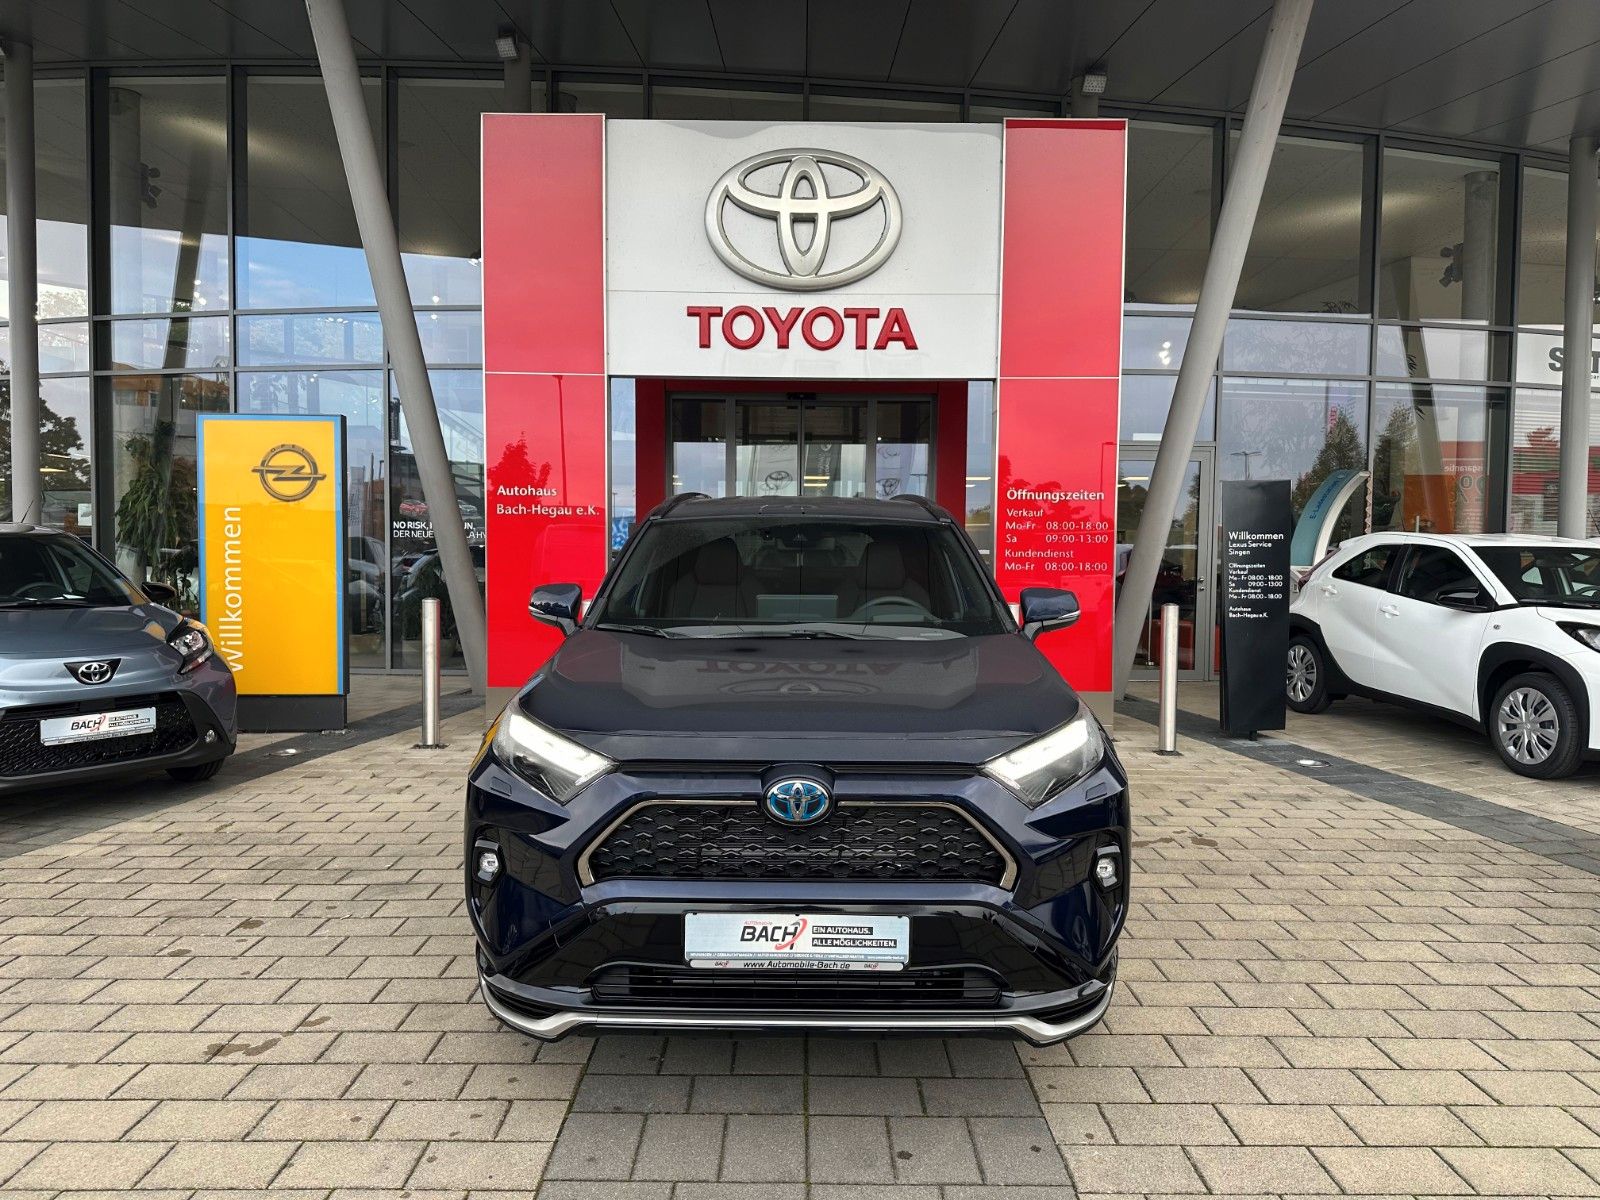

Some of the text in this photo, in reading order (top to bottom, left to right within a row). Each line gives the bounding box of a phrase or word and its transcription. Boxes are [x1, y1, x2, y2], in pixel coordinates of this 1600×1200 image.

[687, 305, 919, 351] TOYOTA
[496, 485, 557, 496] Autohaus
[1006, 487, 1105, 503] Öffnungszeiten
[496, 504, 600, 518] Bach-Hegau e.K.
[1006, 508, 1044, 517] Verkauf
[393, 521, 406, 529] NO
[407, 521, 429, 530] RISK,
[1005, 521, 1109, 530] Mo-Fr 08:00-18:00
[1006, 534, 1108, 543] Sa 09:00-13:00
[1228, 531, 1284, 540] Willkommen
[1005, 549, 1074, 558] Kundendienst
[1229, 548, 1250, 556] Singen
[1004, 562, 1107, 571] Mo-Fr 08:00-18:00
[218, 507, 244, 672] Willkommen
[71, 719, 102, 731] BACH
[812, 926, 871, 935] EIN AUTOHAUS.
[740, 924, 800, 950] BACH
[812, 938, 896, 948] ALLE MÖGLICHKEITEN.
